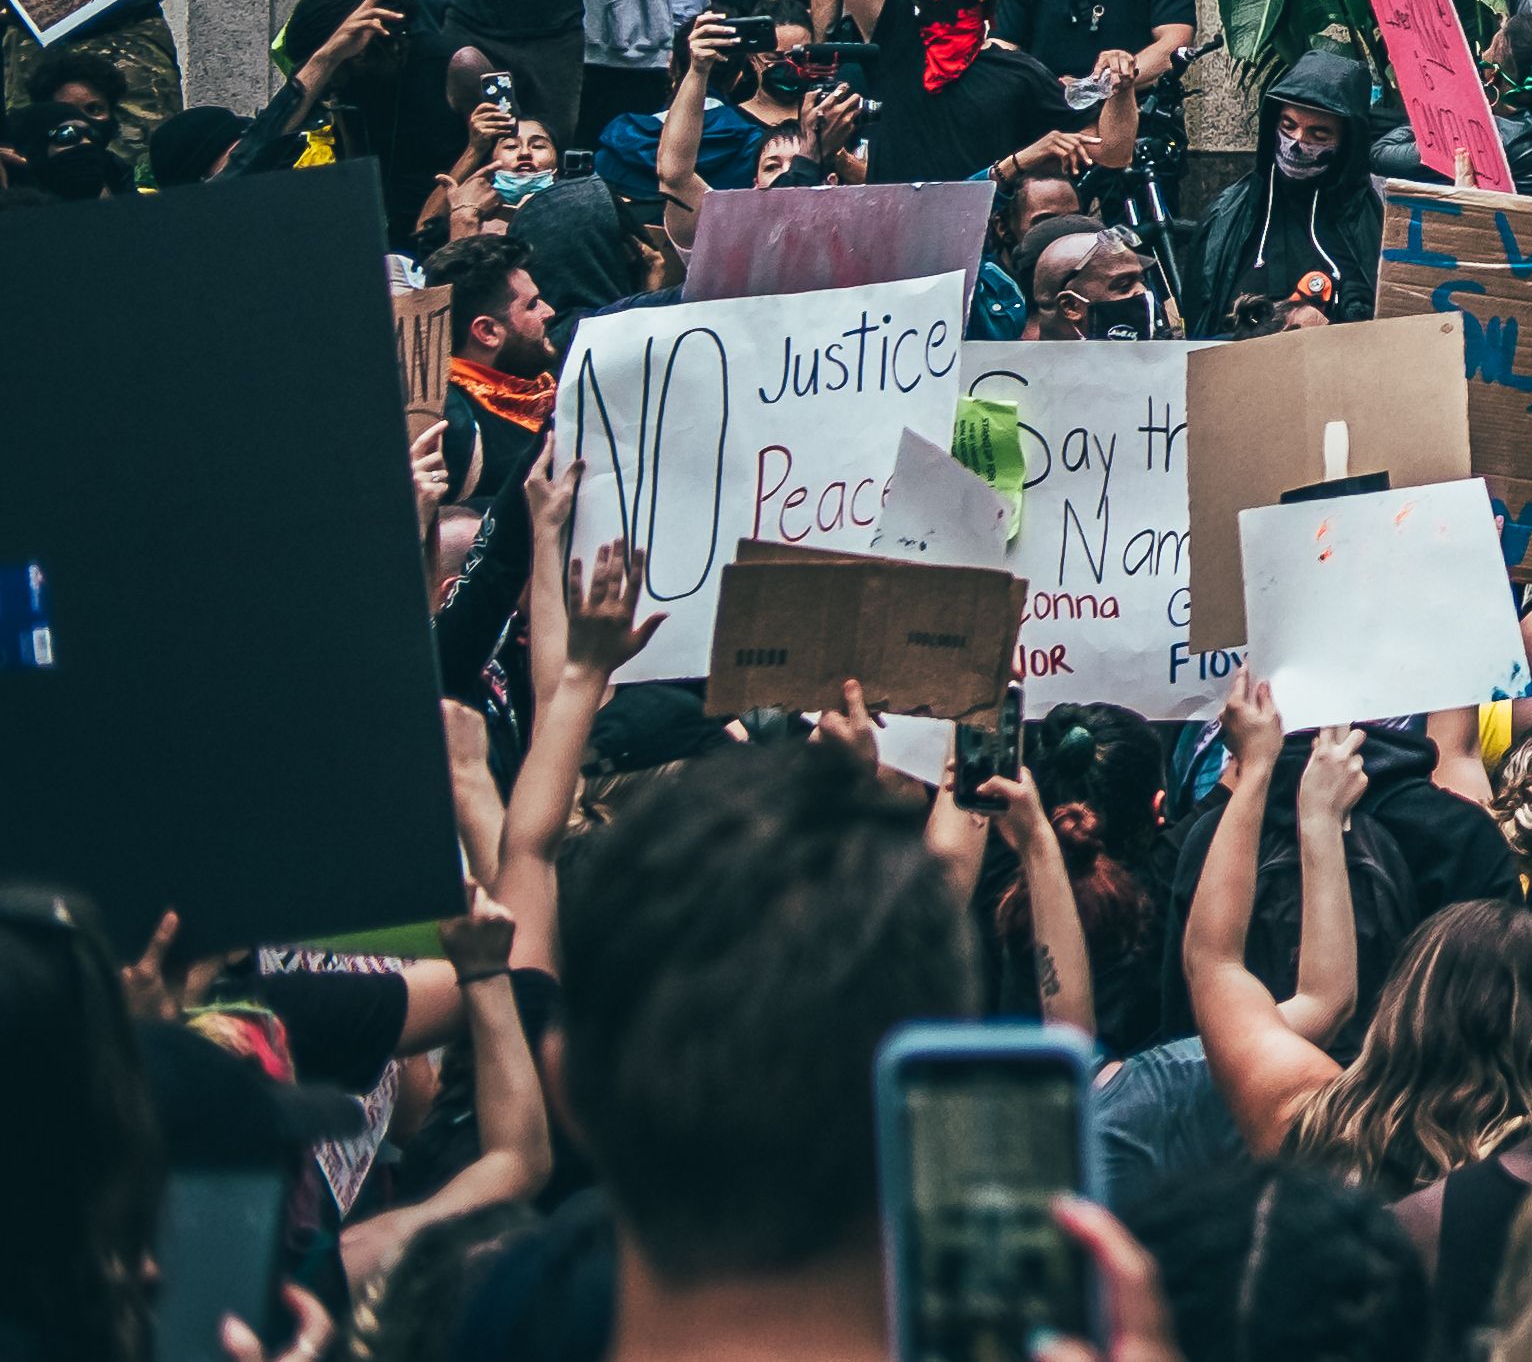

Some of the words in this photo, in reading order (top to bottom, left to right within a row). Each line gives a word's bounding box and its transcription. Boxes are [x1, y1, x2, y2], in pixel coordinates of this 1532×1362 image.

[1383, 196, 1462, 268] I
[564, 327, 729, 602] NO
[758, 311, 957, 405] Justice
